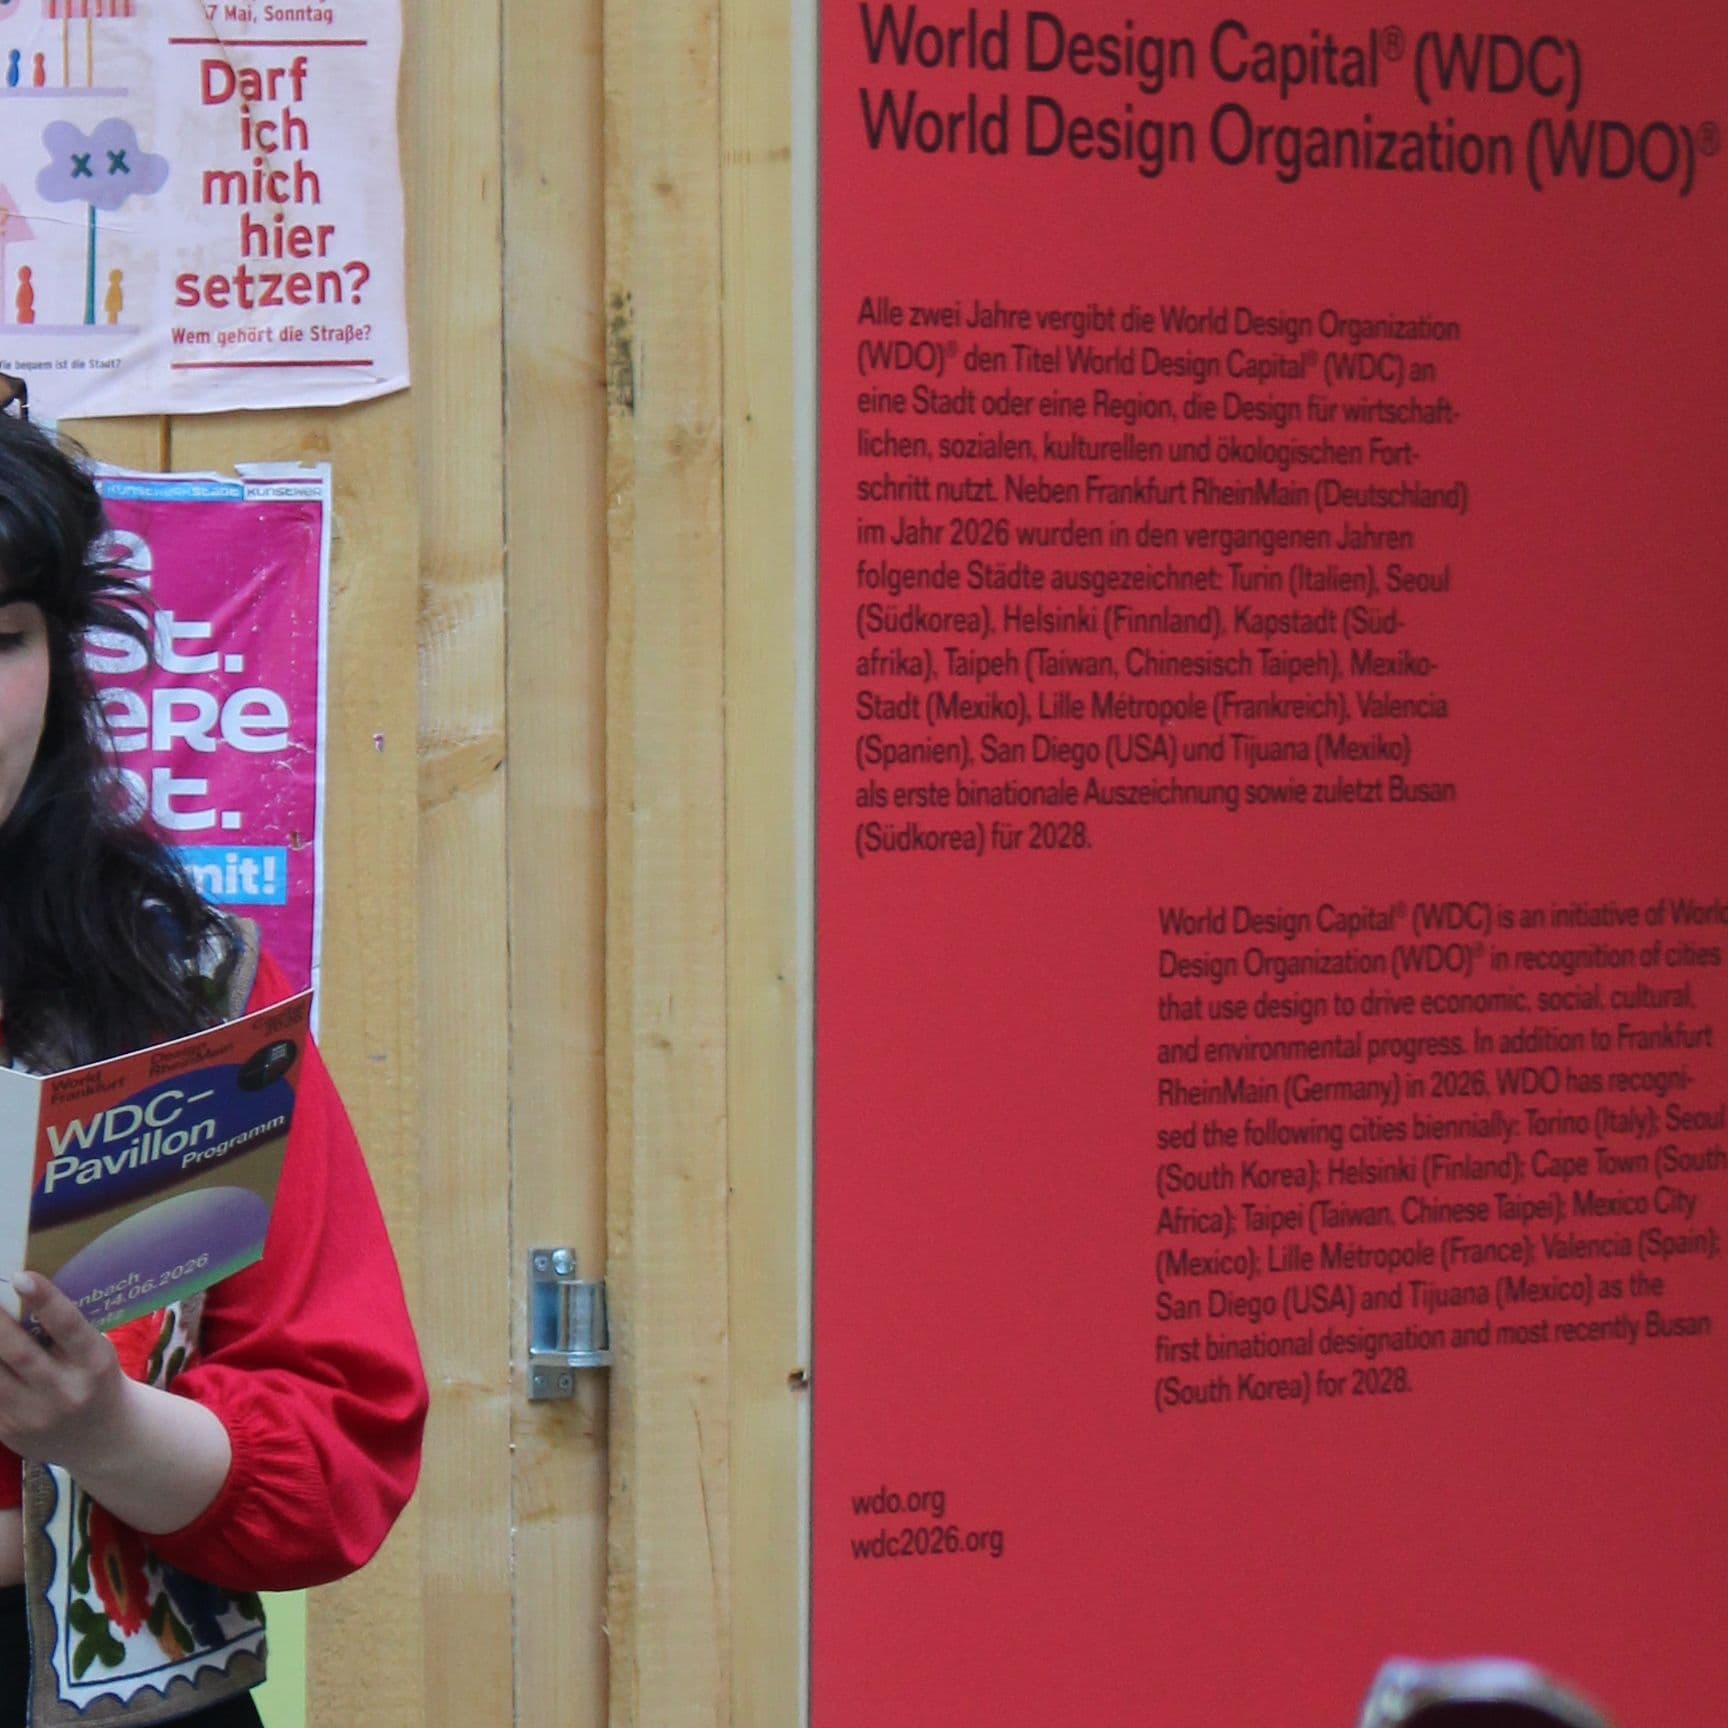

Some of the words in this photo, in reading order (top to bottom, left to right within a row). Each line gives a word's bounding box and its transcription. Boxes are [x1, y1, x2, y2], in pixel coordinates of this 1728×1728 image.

[224, 5, 256, 23] Mai,
[264, 5, 333, 24] Sonntag
[859, 1, 1007, 71] World
[1026, 12, 1196, 93] Design
[1414, 31, 1582, 111] (WDC)
[200, 56, 307, 105] Darf
[241, 105, 307, 151] ich
[859, 87, 1007, 157] World
[1026, 94, 1196, 178] Design
[1210, 102, 1512, 183] Organization
[203, 157, 320, 204] mich
[241, 212, 334, 259] hier
[176, 260, 370, 309] setzen?
[171, 327, 210, 344] Wem
[217, 327, 272, 347] gehört
[280, 325, 303, 342] die
[310, 324, 371, 343] Straße?
[858, 297, 903, 327] Alle
[909, 300, 961, 328] zwei
[967, 299, 1031, 330] Jahre
[1037, 303, 1115, 338] vergibt
[1123, 304, 1154, 333] die
[1160, 305, 1228, 335] World
[1234, 306, 1312, 344] Design
[1319, 308, 1461, 346] Organization
[964, 345, 1006, 372] den
[1012, 344, 1060, 373] Titel
[1067, 345, 1134, 375] World
[1142, 347, 1220, 384] Design
[1323, 351, 1404, 389] (WDC)
[1409, 361, 1437, 382] an
[858, 387, 905, 413] eine
[912, 384, 975, 415] Stadt
[982, 388, 1034, 416] oder
[1039, 389, 1086, 417] eine
[1183, 391, 1216, 419] die
[1223, 391, 1301, 429] Design
[1308, 394, 1338, 422] für
[1342, 396, 1460, 424] wirtschaft-
[857, 427, 933, 461] lichen,
[939, 431, 1038, 462] sozialen,
[1044, 431, 1163, 461] kulturellen
[1168, 435, 1211, 463] und
[1216, 435, 1363, 472] ökologischen
[1369, 437, 1420, 466] Fort-
[857, 473, 930, 502] schritt
[936, 477, 997, 503] nutzt.
[1004, 474, 1079, 504] Neben
[1085, 475, 1186, 505] Frankfurt
[1192, 476, 1309, 505] RheinMain
[1315, 478, 1467, 516] (Deutschland)
[1158, 906, 1226, 935] World
[1232, 906, 1312, 941] Design
[1413, 901, 1491, 937] (WDC)
[1498, 903, 1514, 929] is
[1519, 909, 1545, 928] an
[1551, 901, 1640, 928] initiative
[1645, 898, 1666, 926] of
[1158, 949, 1237, 985] Design
[1243, 947, 1387, 983] Organization
[1491, 945, 1509, 970] in
[1515, 943, 1635, 976] recognition
[1640, 939, 1660, 966] of
[1665, 940, 1722, 967] cities
[1158, 992, 1202, 1021] that
[1209, 998, 1247, 1019] use
[1254, 990, 1327, 1025] design
[1334, 993, 1354, 1016] to
[1361, 989, 1415, 1015] drive
[1422, 986, 1531, 1015] economic,
[1538, 983, 1603, 1012] social,
[44, 1118, 216, 1193] Pavillon
[182, 1114, 285, 1168] Programm
[851, 1485, 946, 1519] wdo.org
[851, 1525, 1005, 1559] wdc2026.org
